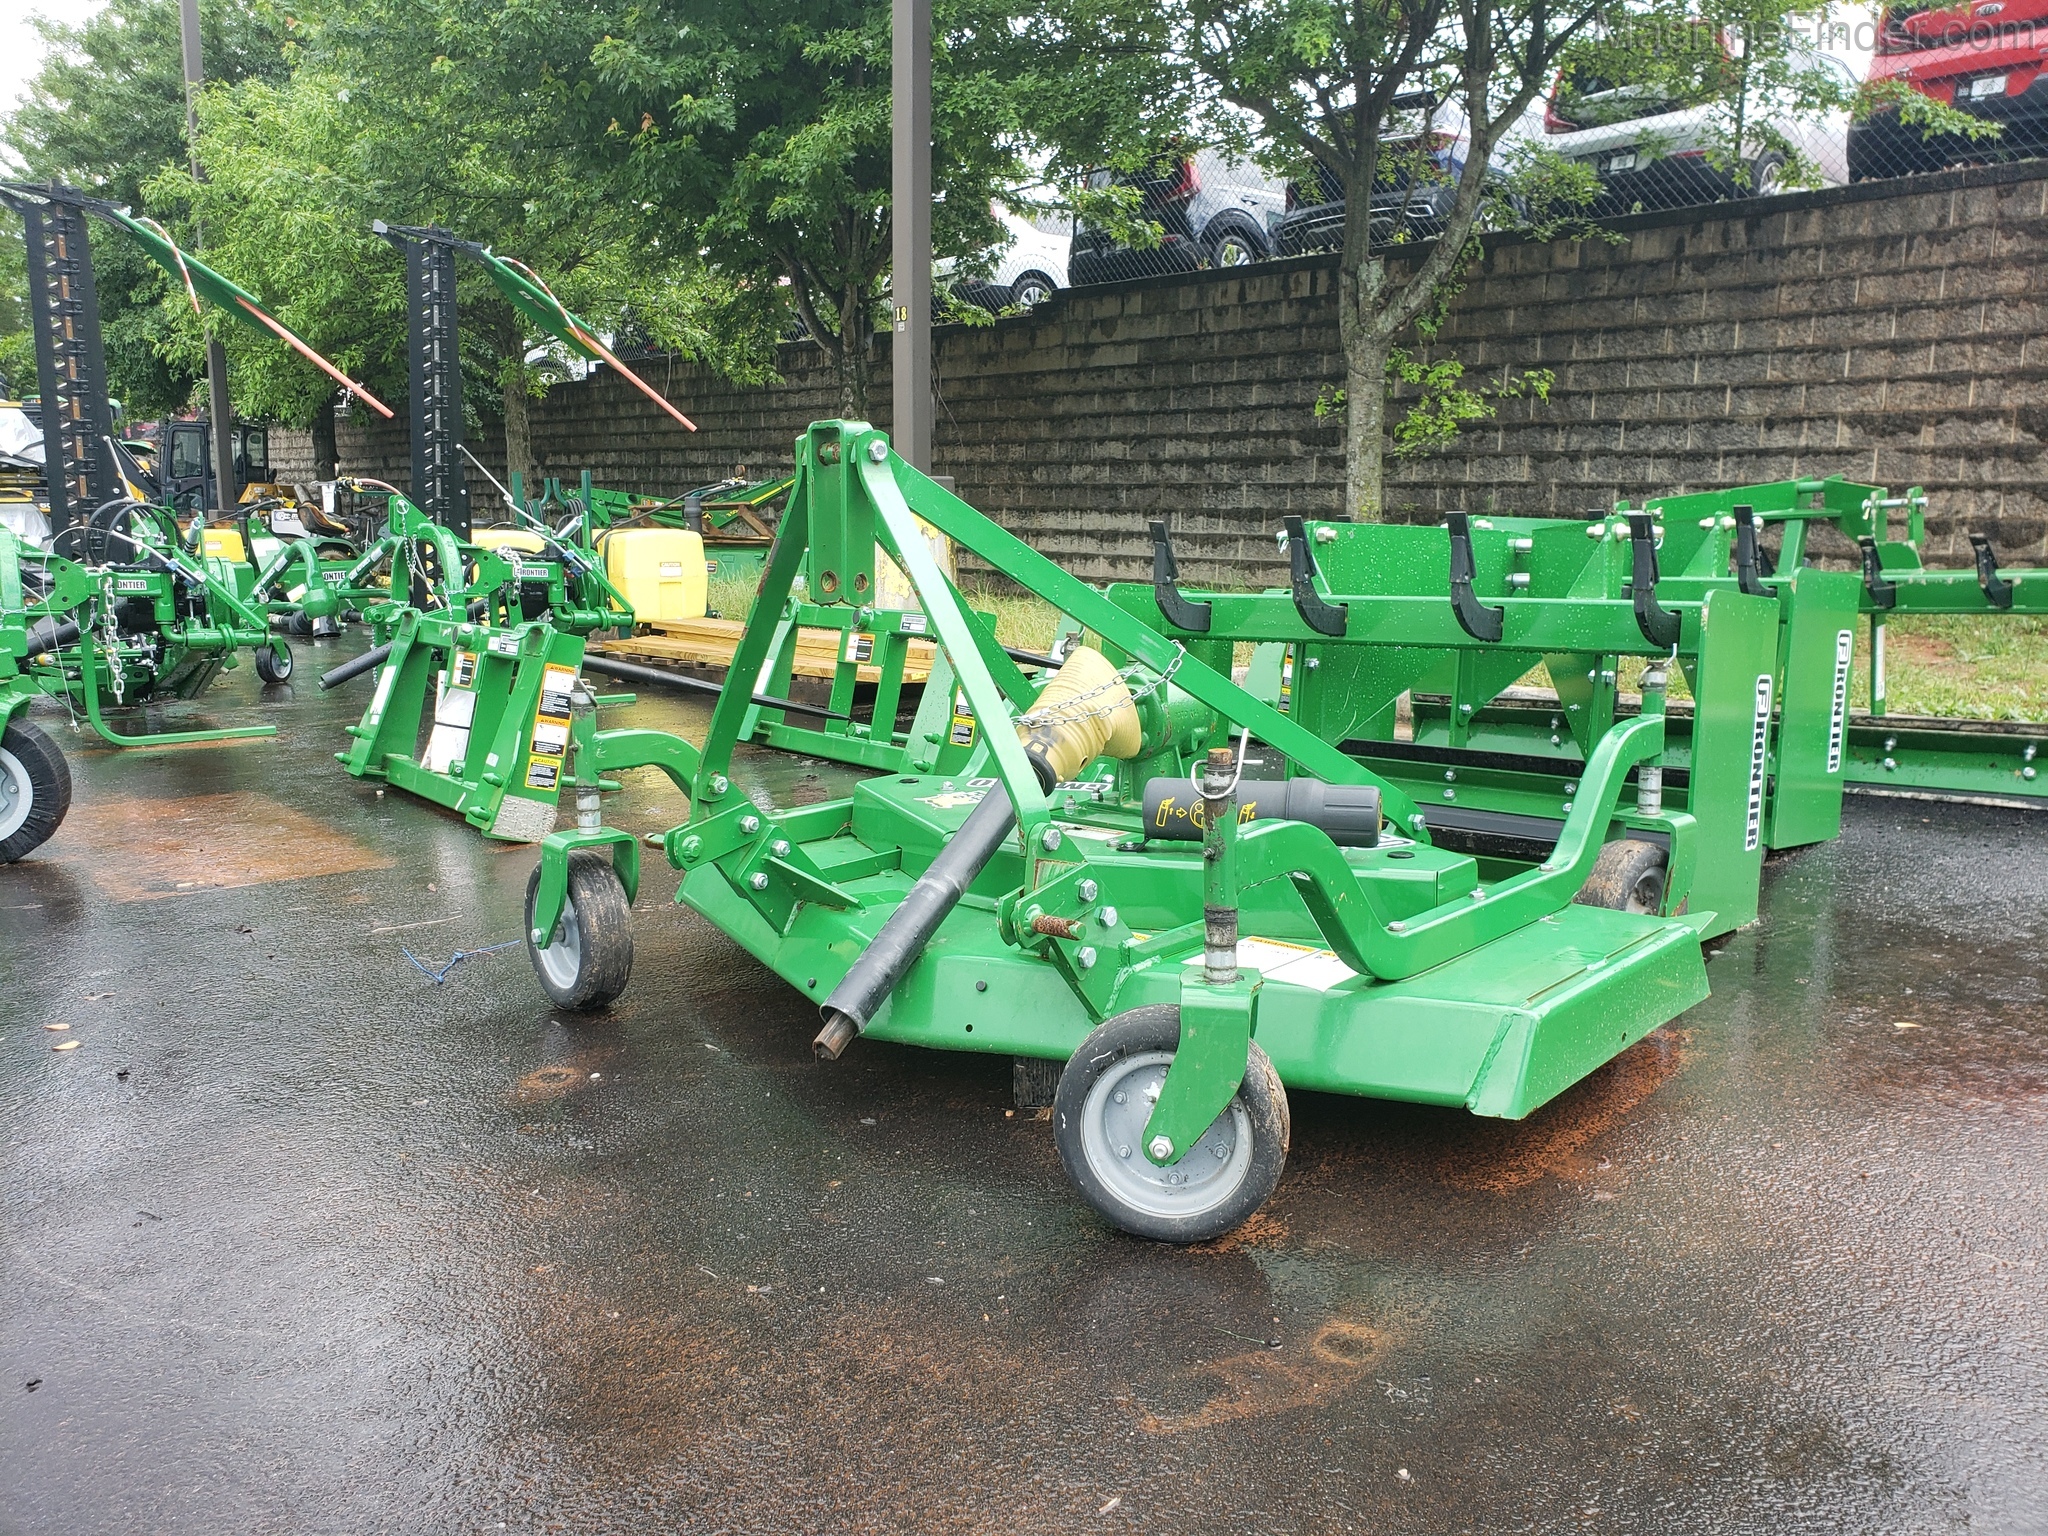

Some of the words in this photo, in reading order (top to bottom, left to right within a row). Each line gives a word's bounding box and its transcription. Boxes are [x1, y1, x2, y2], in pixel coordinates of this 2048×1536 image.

[895, 306, 907, 321] 18
[1747, 678, 1771, 849] FRONTIER
[1829, 633, 1850, 771] FRONTIER
